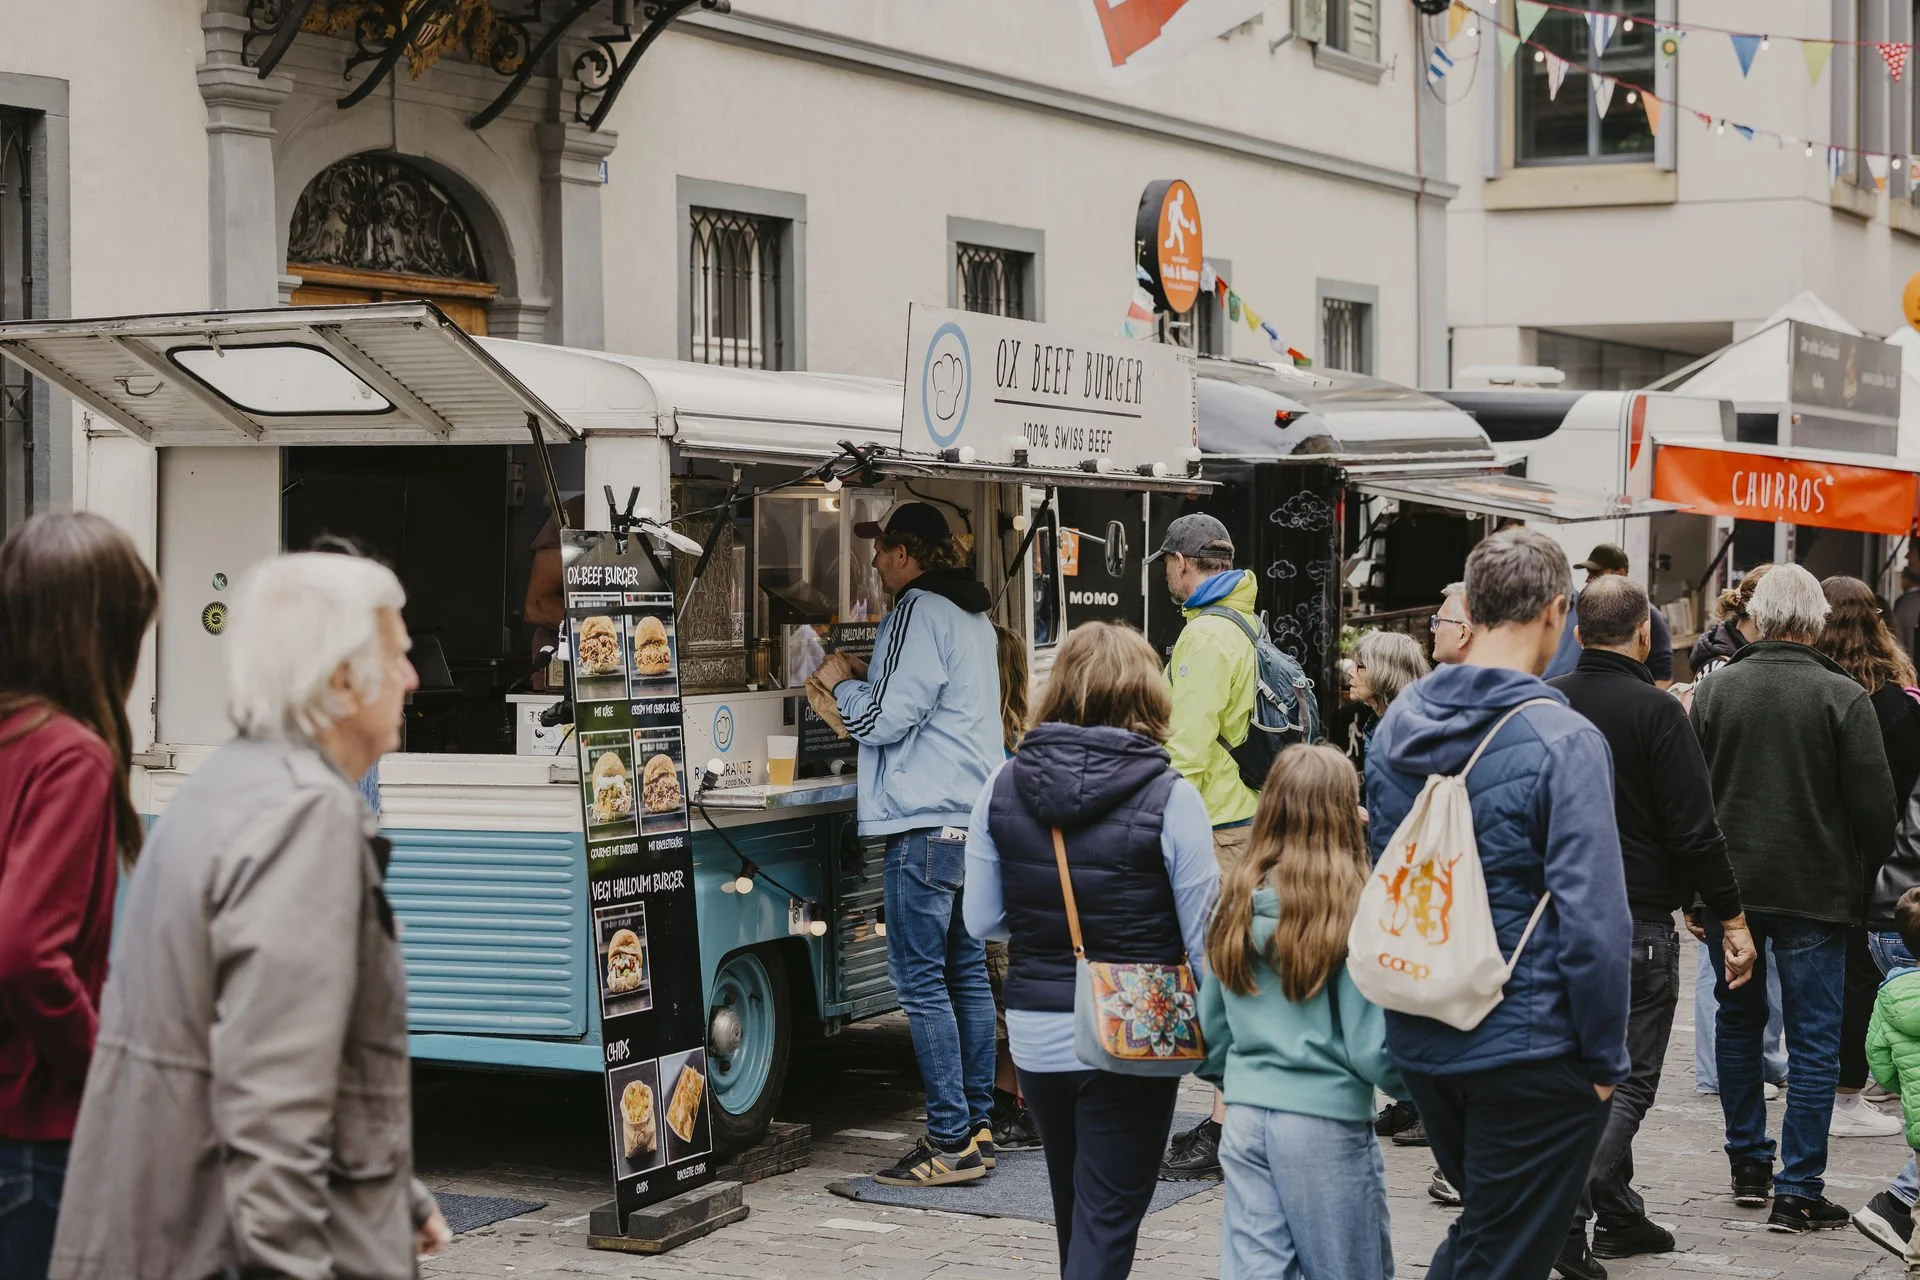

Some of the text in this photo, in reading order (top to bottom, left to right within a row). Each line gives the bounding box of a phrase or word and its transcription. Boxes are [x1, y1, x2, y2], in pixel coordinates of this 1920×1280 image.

[996, 338, 1143, 404] OX BEEF BURGER
[1023, 422, 1113, 453] 100% SWISS BEEF
[1732, 470, 1825, 513] CHURROS
[567, 565, 639, 588] OX-BEEF BURGER
[1069, 590, 1119, 606] MOMO
[841, 626, 877, 642] HALLOUMI BUR
[725, 779, 737, 787] FOOD
[592, 870, 685, 902] VEGI HALLOUMI BURGER
[1378, 953, 1430, 981] coop
[606, 1038, 630, 1062] CHIPS
[636, 1180, 649, 1194] CHIPS
